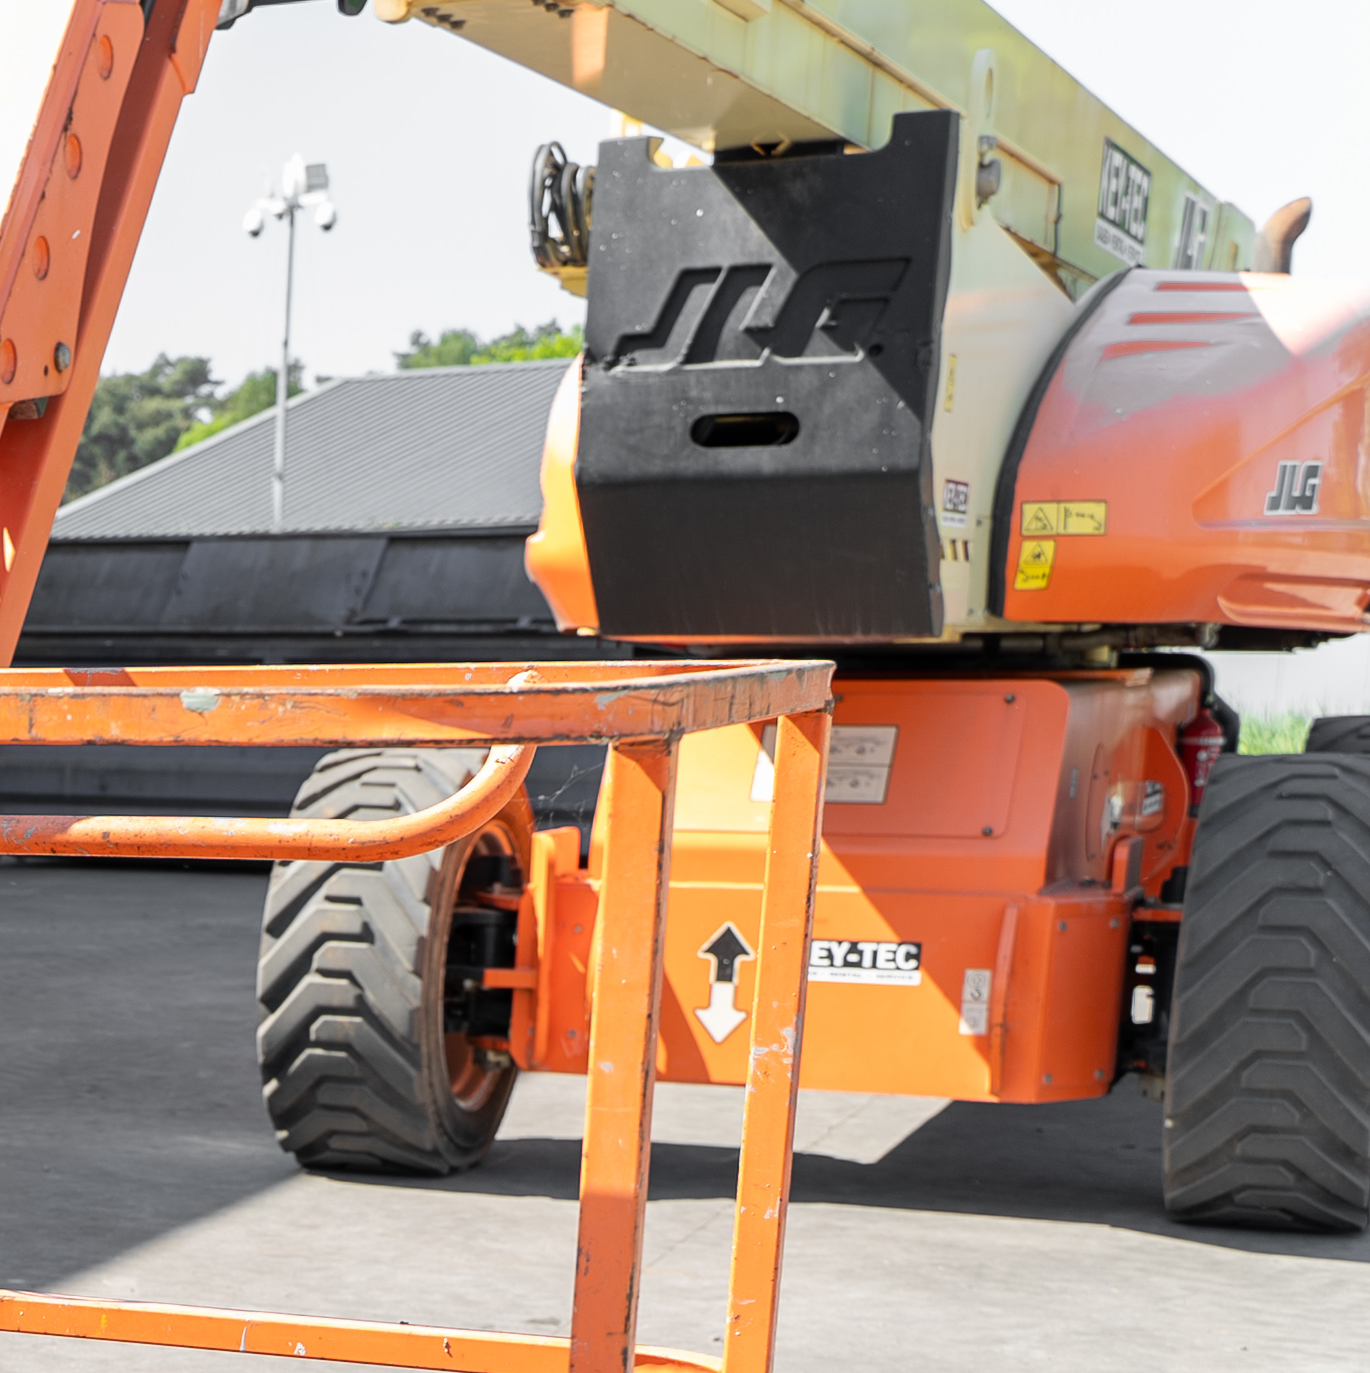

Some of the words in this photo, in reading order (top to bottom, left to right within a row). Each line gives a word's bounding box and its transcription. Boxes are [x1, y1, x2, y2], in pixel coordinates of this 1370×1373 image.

[1099, 144, 1150, 241] KEY-TEC
[609, 258, 910, 373] JLG
[1264, 461, 1322, 515] JLG
[809, 940, 919, 970] EY-TEC
